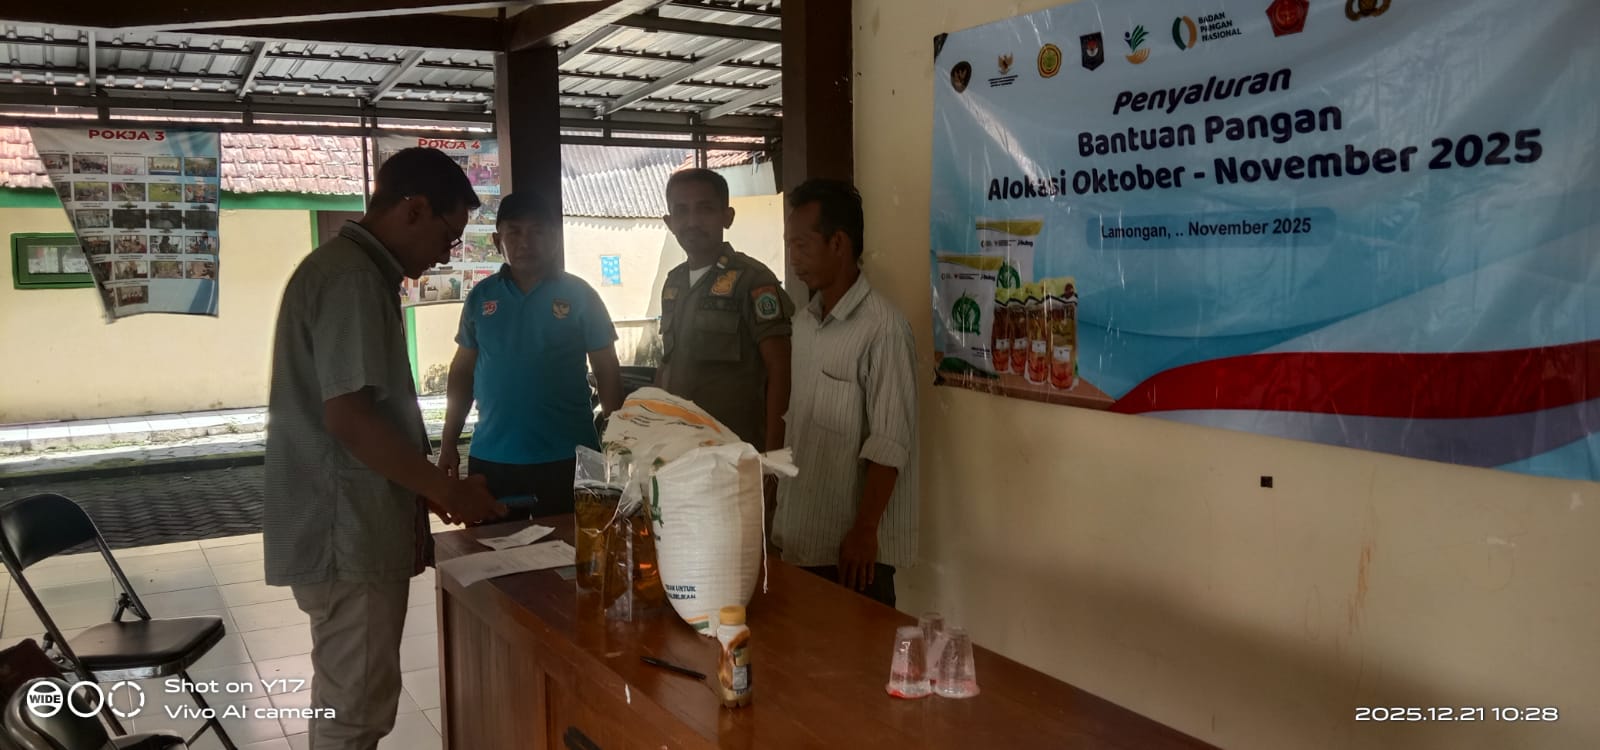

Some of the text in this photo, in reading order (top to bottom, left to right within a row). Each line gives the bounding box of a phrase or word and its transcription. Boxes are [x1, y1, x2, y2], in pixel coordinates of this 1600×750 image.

[1198, 12, 1225, 24] BADAN
[1202, 28, 1242, 42] NASIONAL
[1113, 68, 1292, 115] Penyaluran
[88, 129, 165, 141] POKJA 3
[1078, 106, 1342, 157] Bantuan Pangan
[418, 138, 480, 149] POKJA 4
[988, 169, 1066, 201] Alokasi
[1072, 164, 1185, 195] Oktober
[1213, 144, 1418, 185] November
[1428, 128, 1543, 169] 2025
[1101, 223, 1171, 240] Lamongan,
[1188, 220, 1268, 236] November
[1272, 217, 1311, 234] 2025
